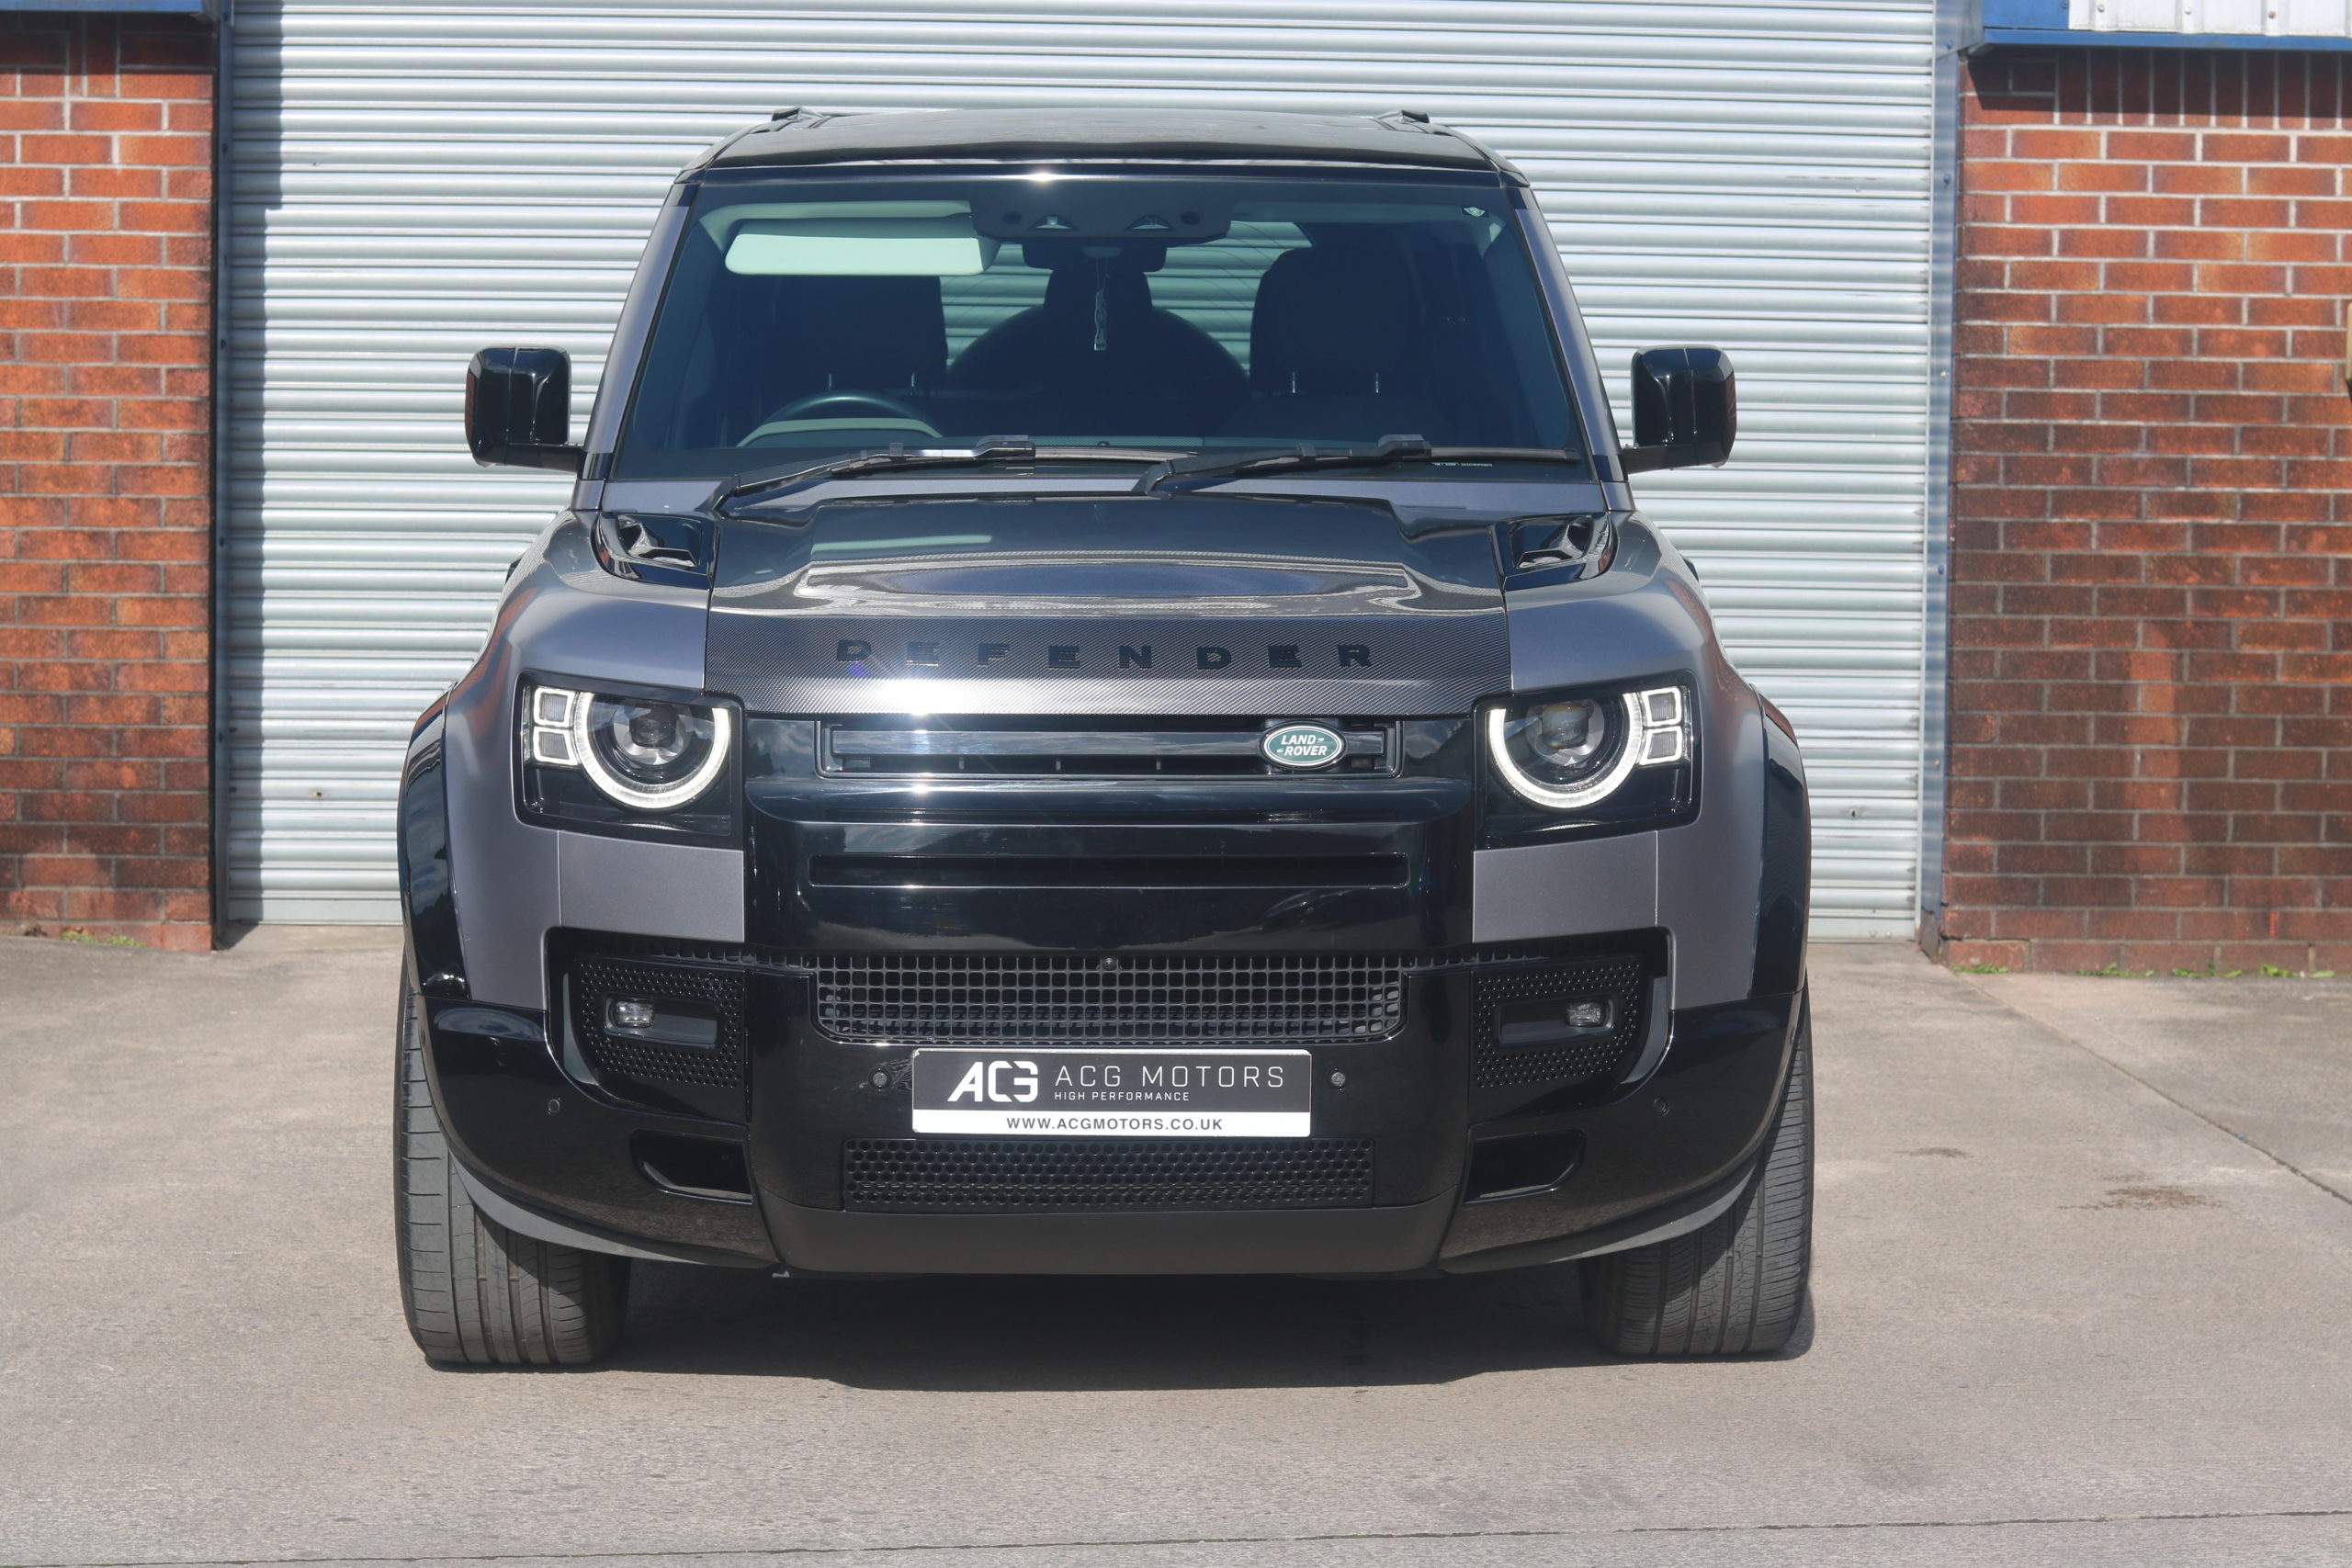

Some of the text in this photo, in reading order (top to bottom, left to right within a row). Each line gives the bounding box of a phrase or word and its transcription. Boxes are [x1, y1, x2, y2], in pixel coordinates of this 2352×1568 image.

[836, 639, 1373, 670] DEFENDER
[1281, 735, 1317, 745] LAND
[1284, 746, 1329, 756] ROVER
[946, 1060, 1039, 1103] ACG
[1055, 1065, 1284, 1088] ACG MOTORS
[1054, 1091, 1190, 1101] HIGH PERFORMANCE
[1006, 1117, 1223, 1131] WWW.ACGMOTORS.CO.UK
